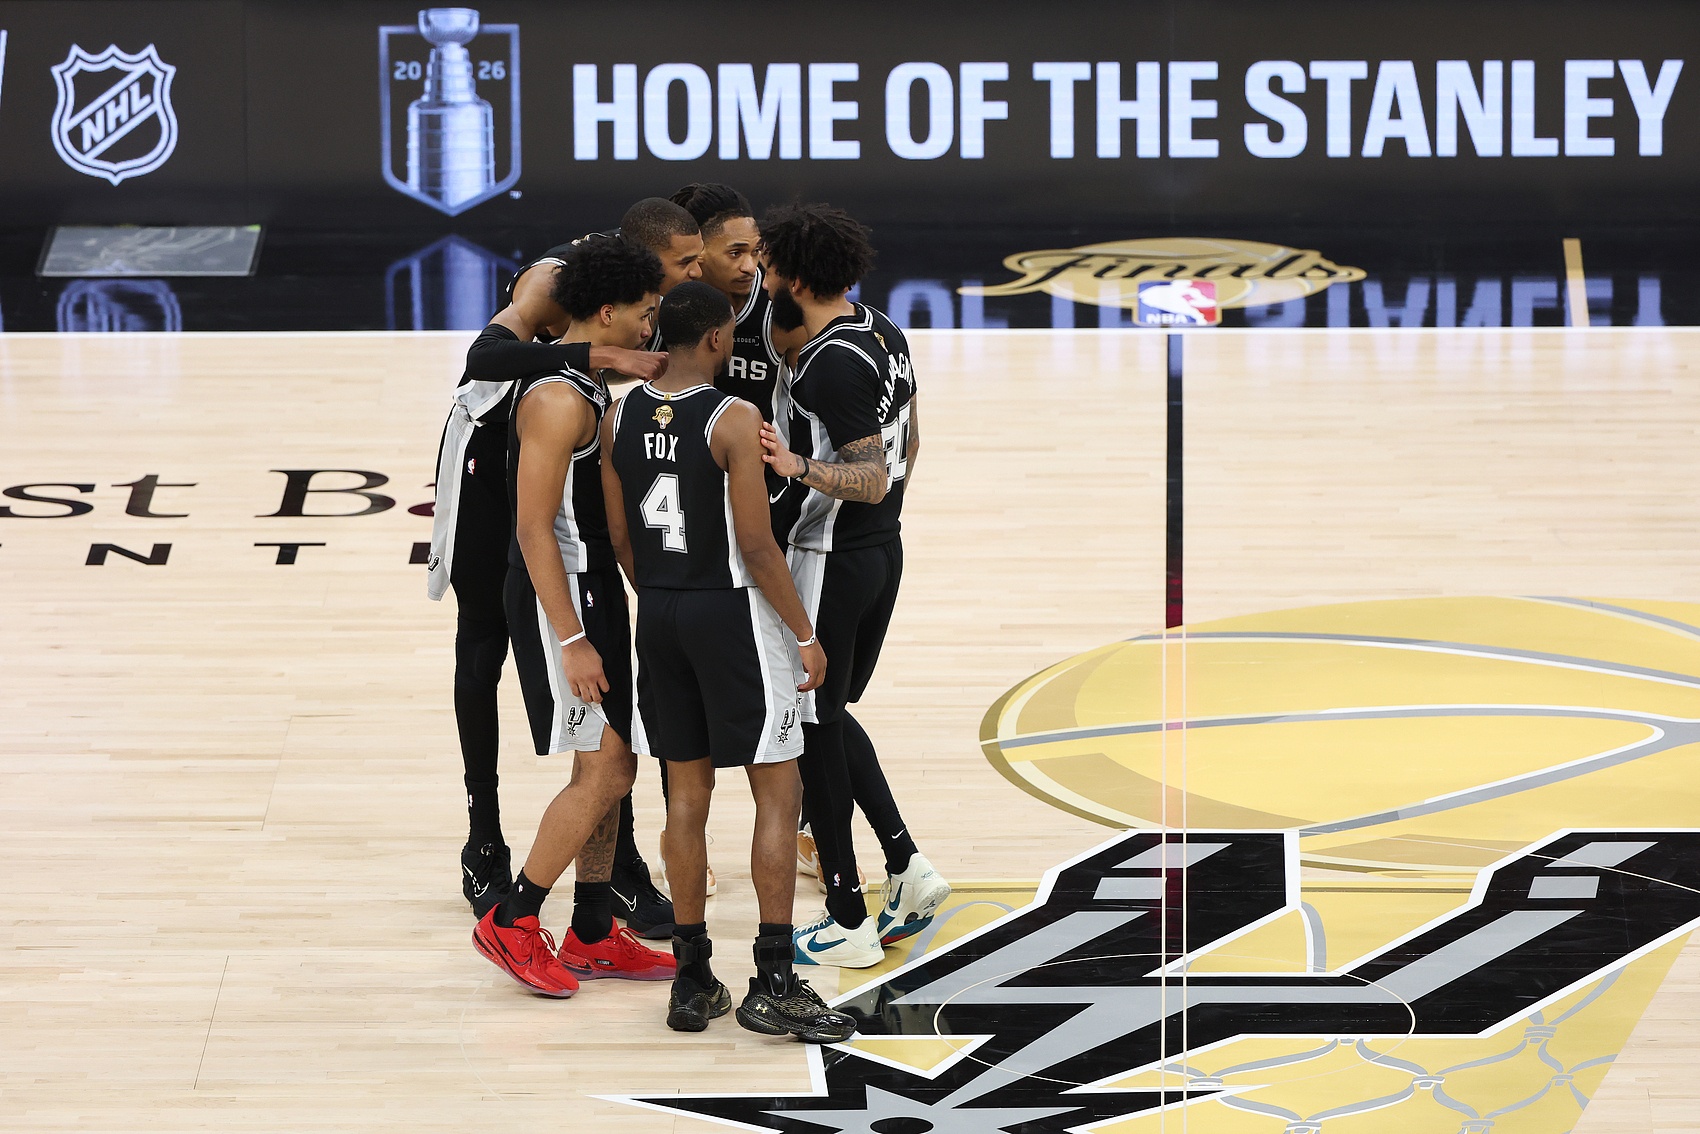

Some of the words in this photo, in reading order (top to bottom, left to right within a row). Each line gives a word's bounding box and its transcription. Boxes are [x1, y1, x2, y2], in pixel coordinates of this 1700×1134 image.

[394, 61, 421, 80] 20
[478, 61, 505, 80] 26
[81, 81, 151, 152] NHL
[573, 63, 860, 160] HOME
[886, 62, 1008, 160] OF
[1033, 61, 1219, 158] THE
[1244, 60, 1683, 158] STANLEY
[998, 249, 1350, 288] Finals
[1146, 313, 1188, 324] NBA
[643, 432, 679, 463] FOX
[639, 472, 688, 554] 4
